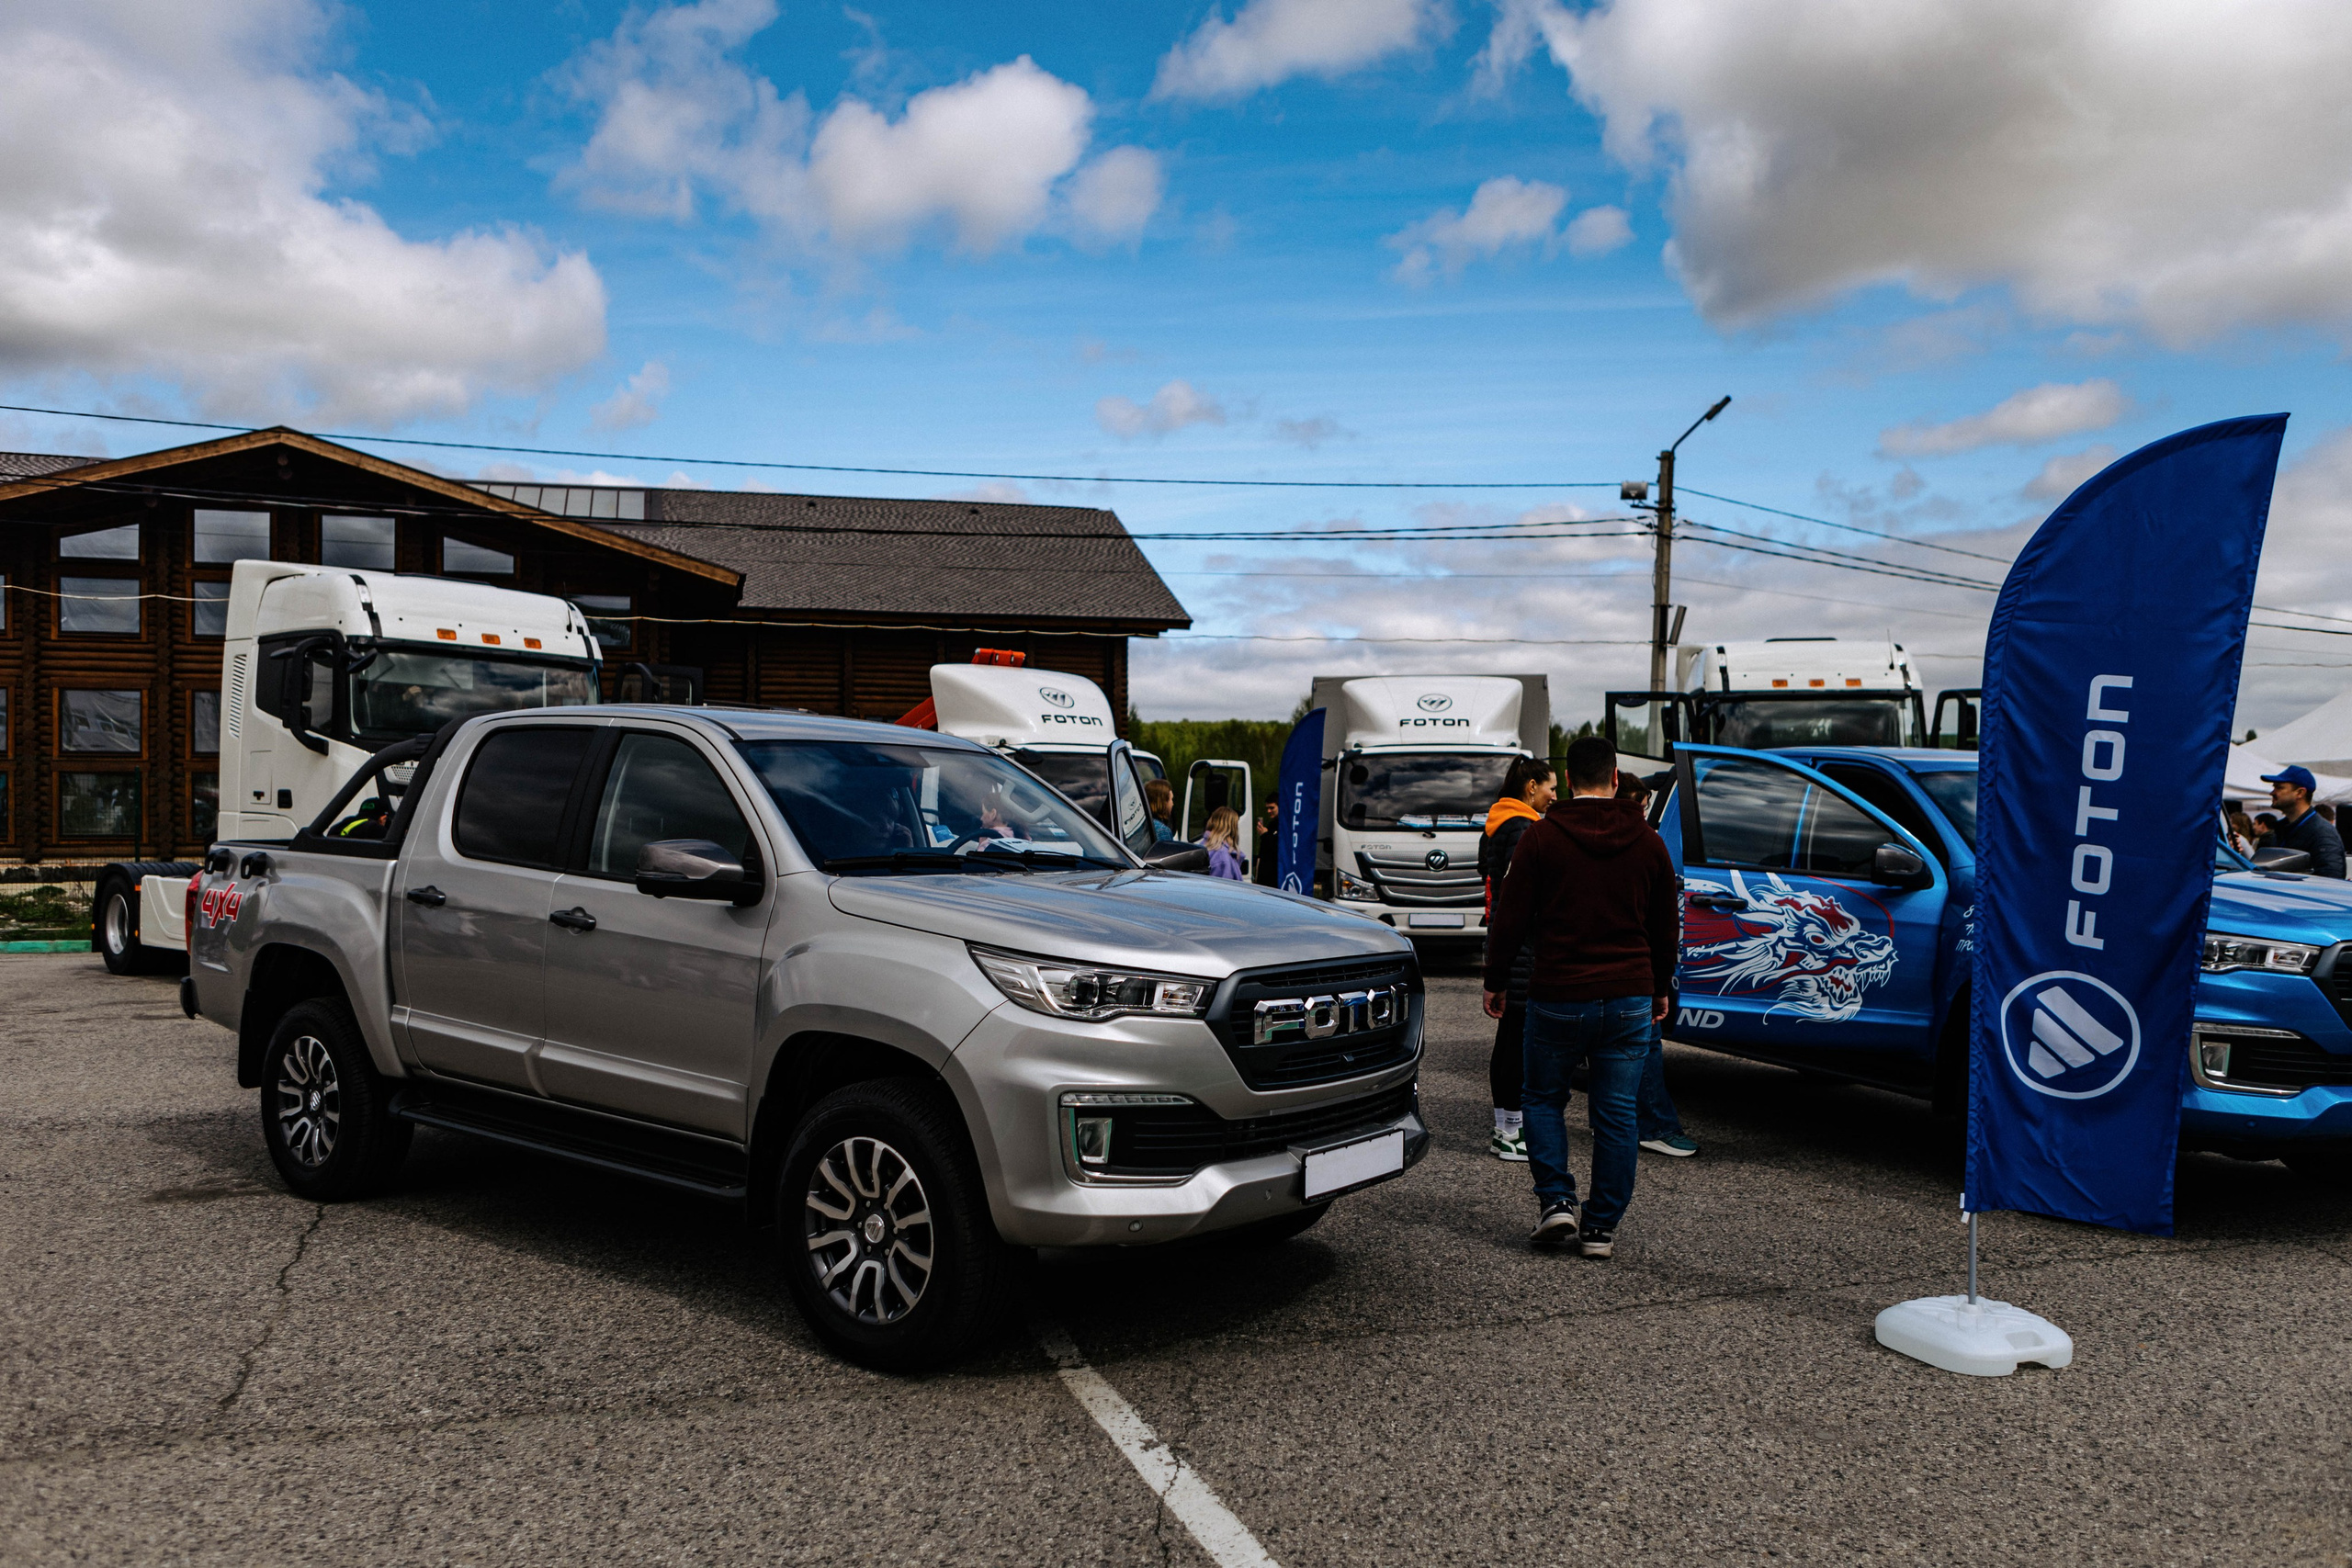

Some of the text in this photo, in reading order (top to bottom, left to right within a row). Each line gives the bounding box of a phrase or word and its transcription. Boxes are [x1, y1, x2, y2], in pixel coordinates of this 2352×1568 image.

[1041, 714, 1103, 727] FOTON
[1399, 717, 1470, 728] FOTON
[2064, 673, 2133, 951] FOTON
[1254, 982, 1409, 1045] FOTON
